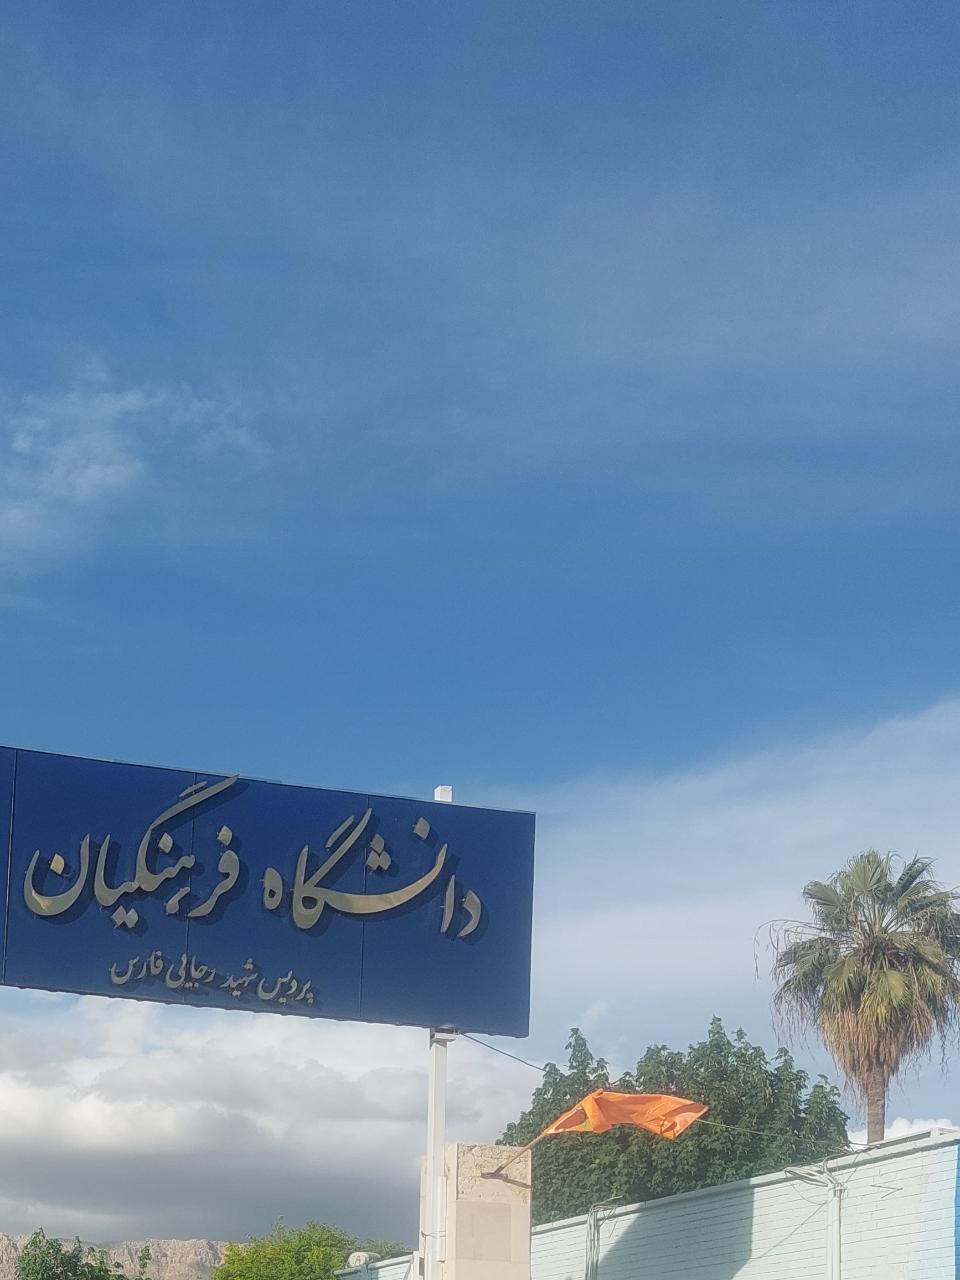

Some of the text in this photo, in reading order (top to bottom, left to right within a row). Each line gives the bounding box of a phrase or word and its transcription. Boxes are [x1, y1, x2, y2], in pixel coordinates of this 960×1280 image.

[24, 775, 484, 937] دانشگاه فرهنگیان
[110, 950, 164, 985] فارس
[220, 958, 258, 997] شهید
[257, 970, 314, 1006] پردیس
